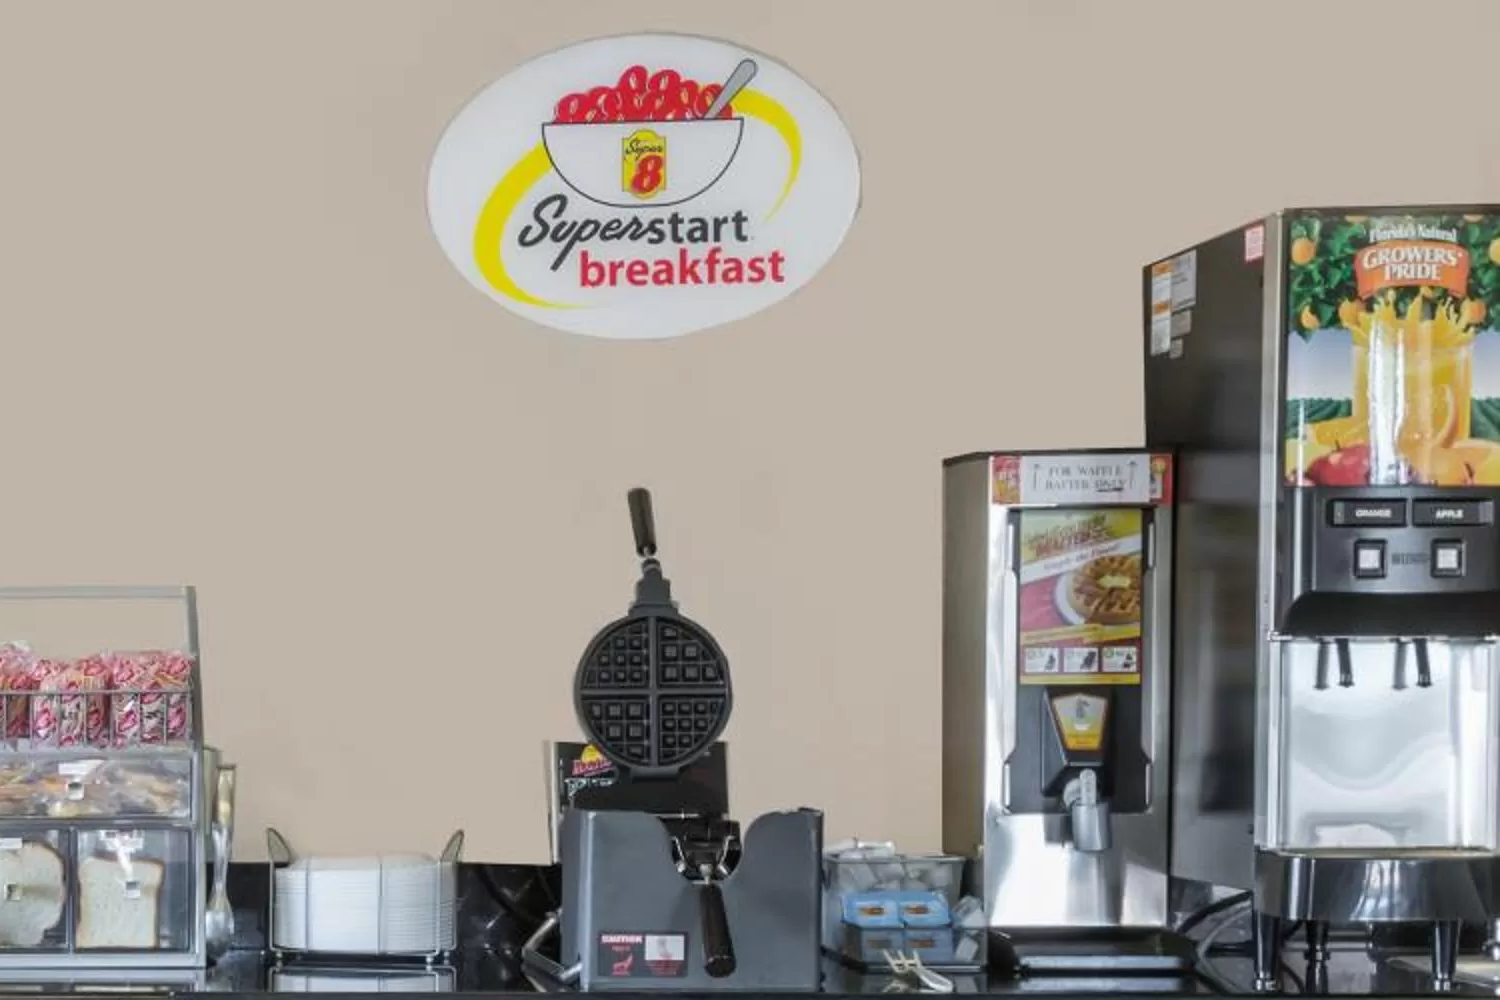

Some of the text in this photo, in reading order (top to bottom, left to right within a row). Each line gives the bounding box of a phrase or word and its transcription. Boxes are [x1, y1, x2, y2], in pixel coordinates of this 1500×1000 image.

[630, 154, 664, 194] 8
[517, 194, 749, 271] Superstart
[579, 247, 786, 288] breakfast
[1384, 263, 1442, 281] PRIDE
